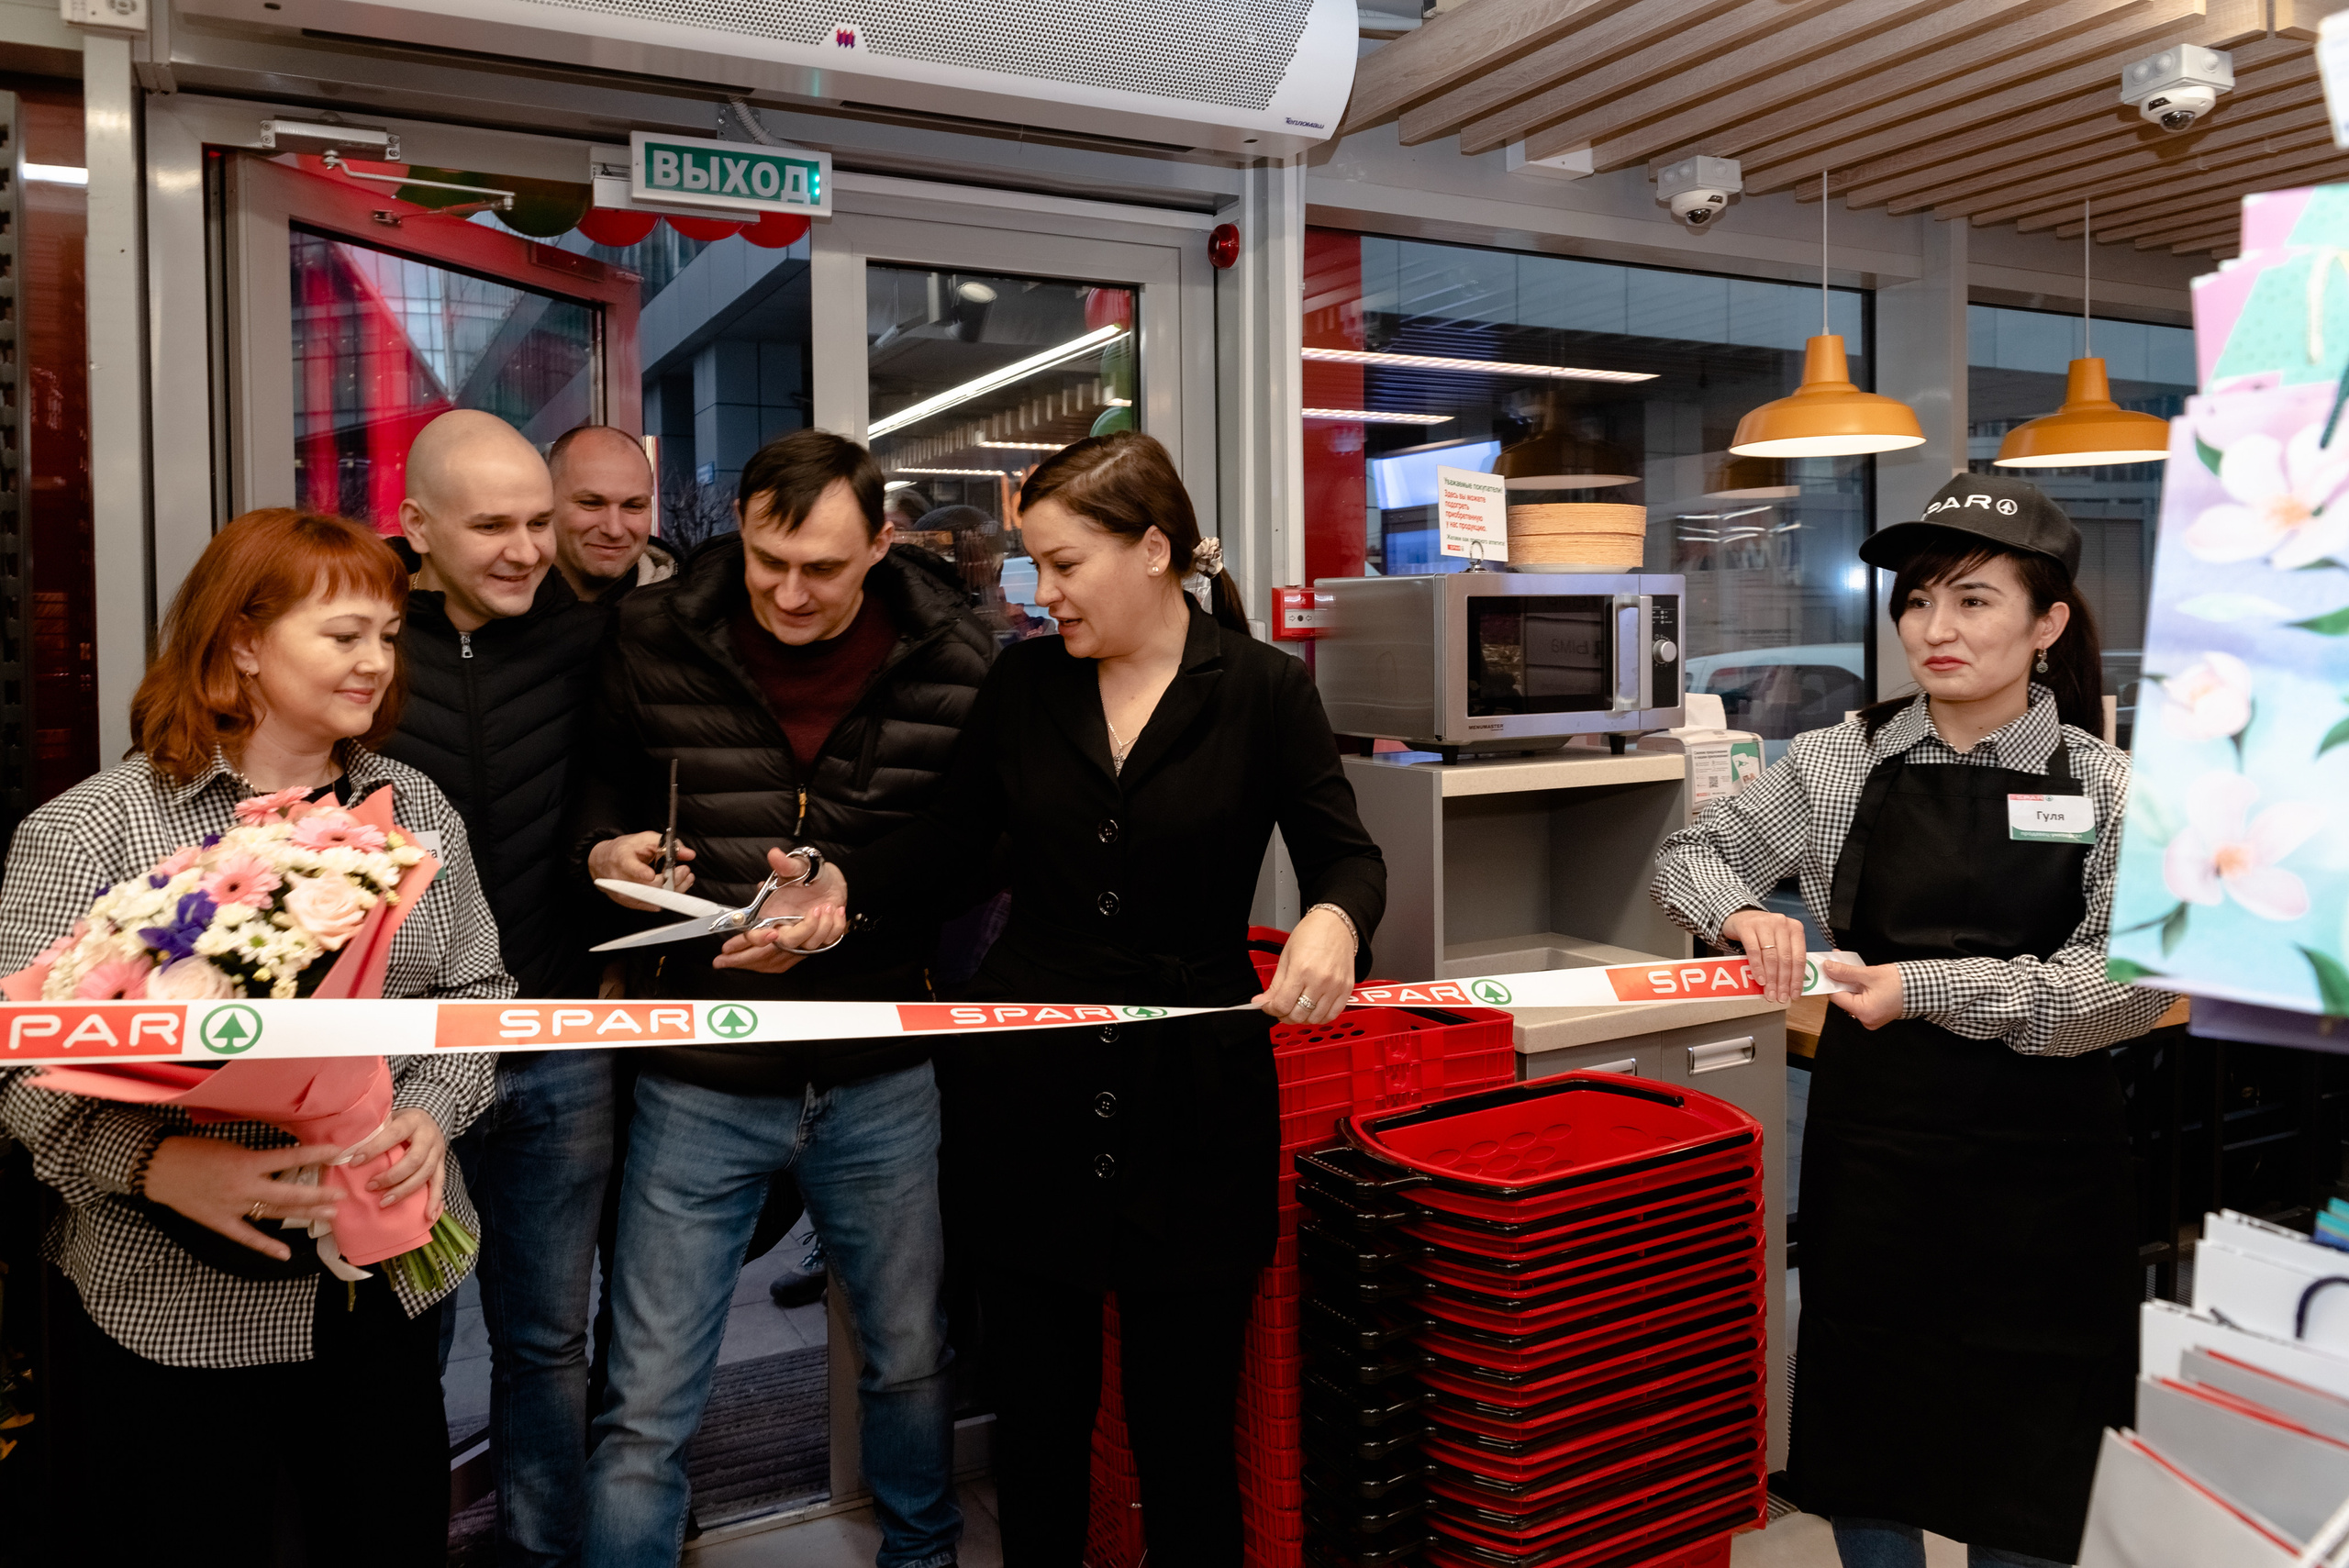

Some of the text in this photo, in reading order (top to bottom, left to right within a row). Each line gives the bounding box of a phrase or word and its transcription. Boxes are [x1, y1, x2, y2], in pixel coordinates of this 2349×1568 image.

[652, 150, 811, 205] ВЫХОД
[1443, 477, 1473, 489] Уважаемые
[1444, 489, 1459, 499] Здесь
[1466, 495, 1486, 503] можете
[1444, 500, 1470, 511] подогреть
[2036, 810, 2065, 822] Гуля
[950, 1006, 1112, 1025] SPAR
[499, 1008, 690, 1039] SPAR
